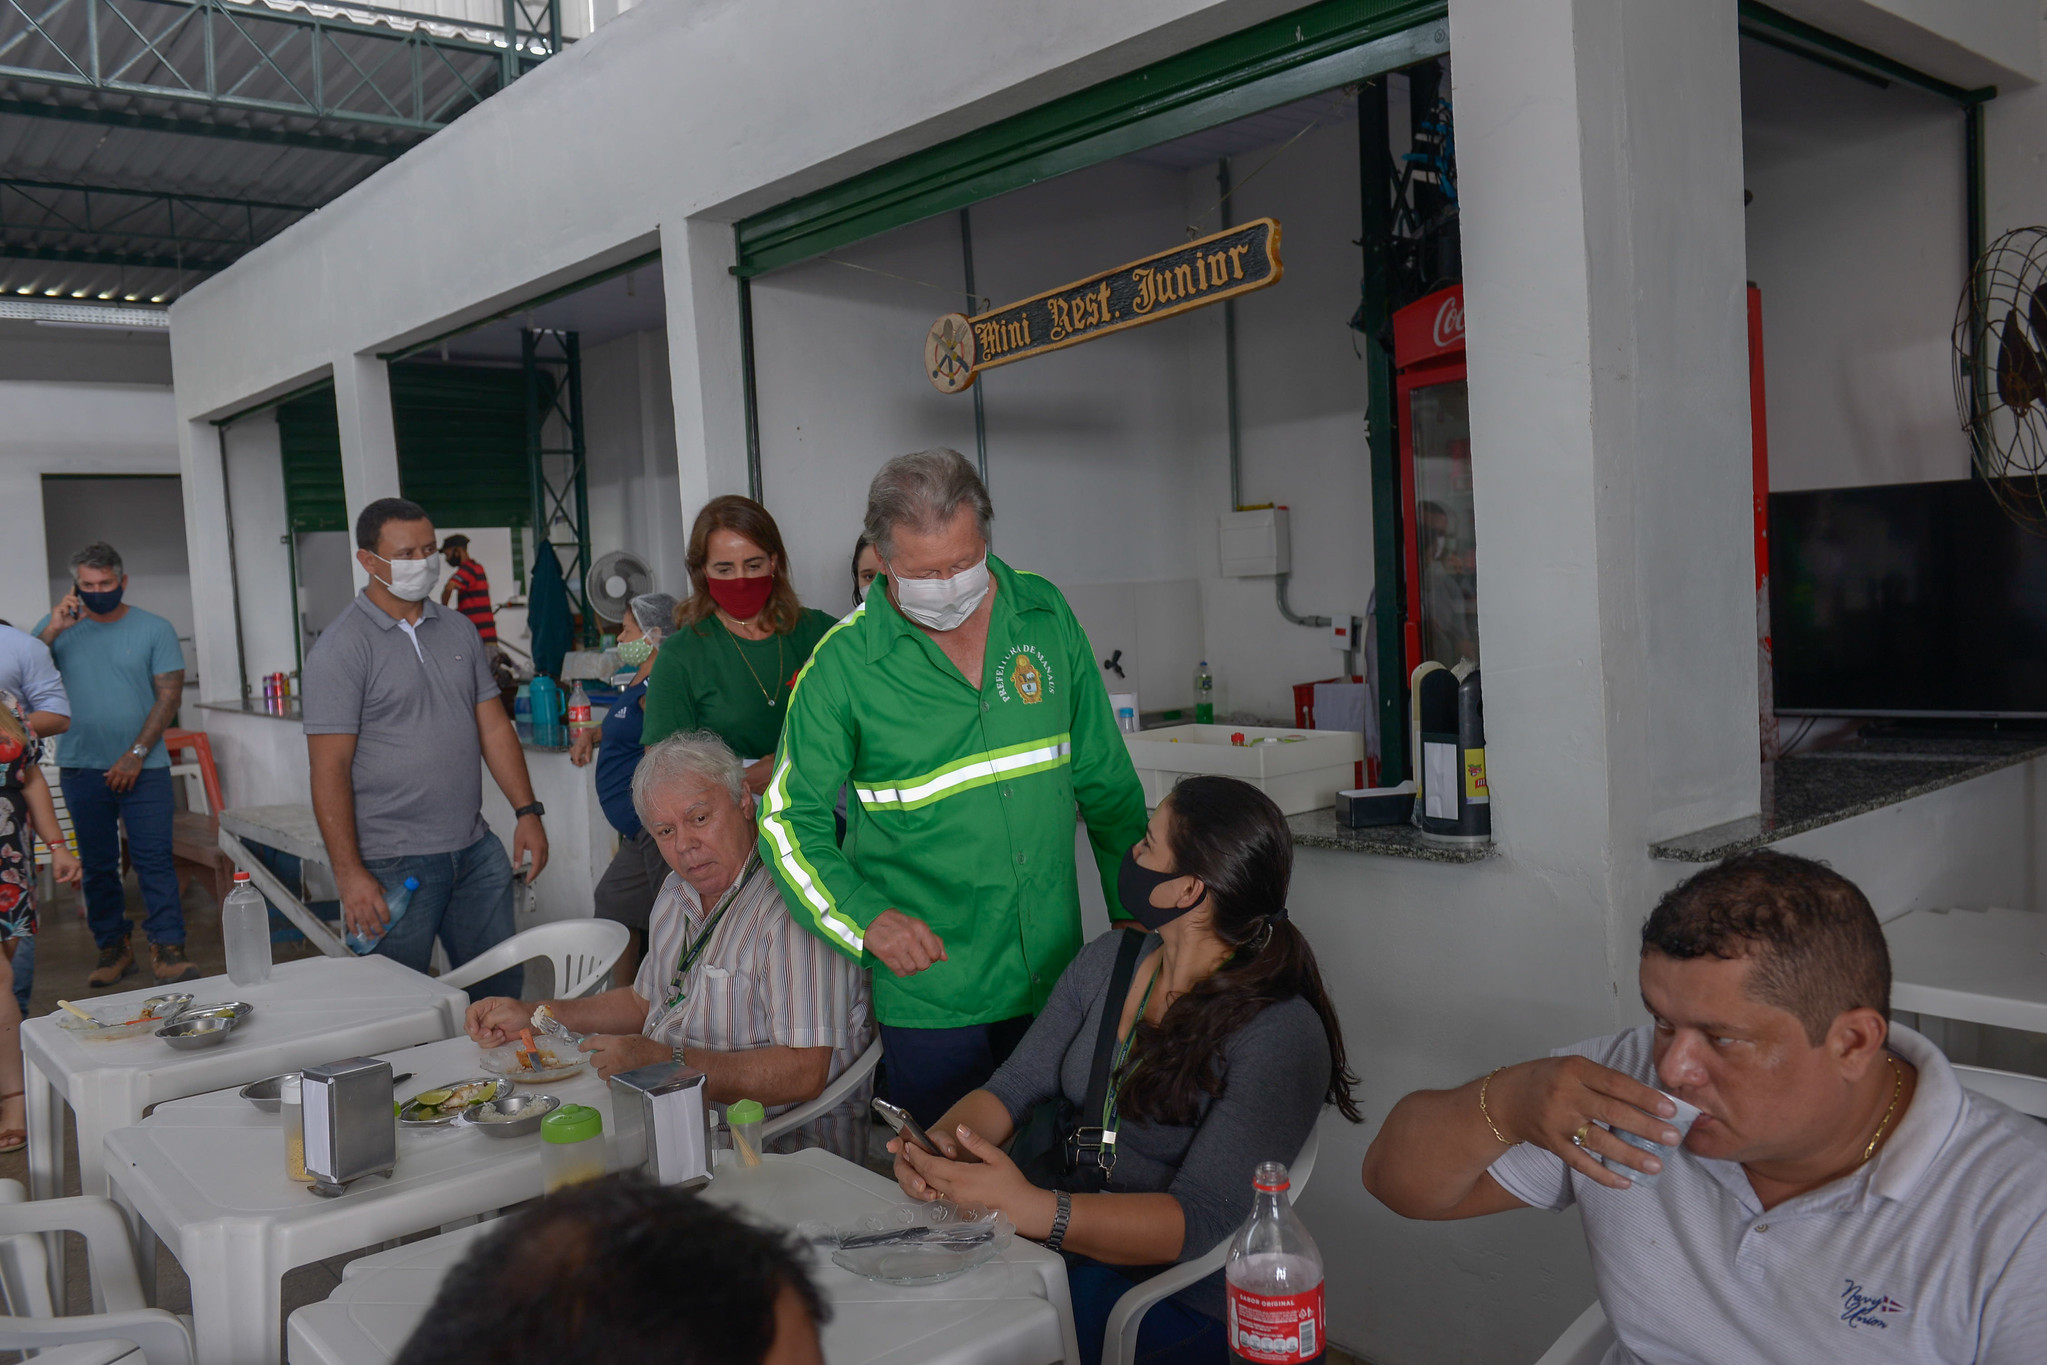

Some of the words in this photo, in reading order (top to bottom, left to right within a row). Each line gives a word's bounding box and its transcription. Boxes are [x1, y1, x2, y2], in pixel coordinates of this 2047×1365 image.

[975, 312, 1031, 361] Mini
[1047, 281, 1121, 341] Rest.
[1132, 243, 1249, 314] Junior
[1022, 644, 1037, 654] DE
[1036, 651, 1055, 695] MANAUS
[1239, 1293, 1260, 1305] SABOR
[1840, 1278, 1883, 1313] Navy
[1840, 1304, 1888, 1329] Union
